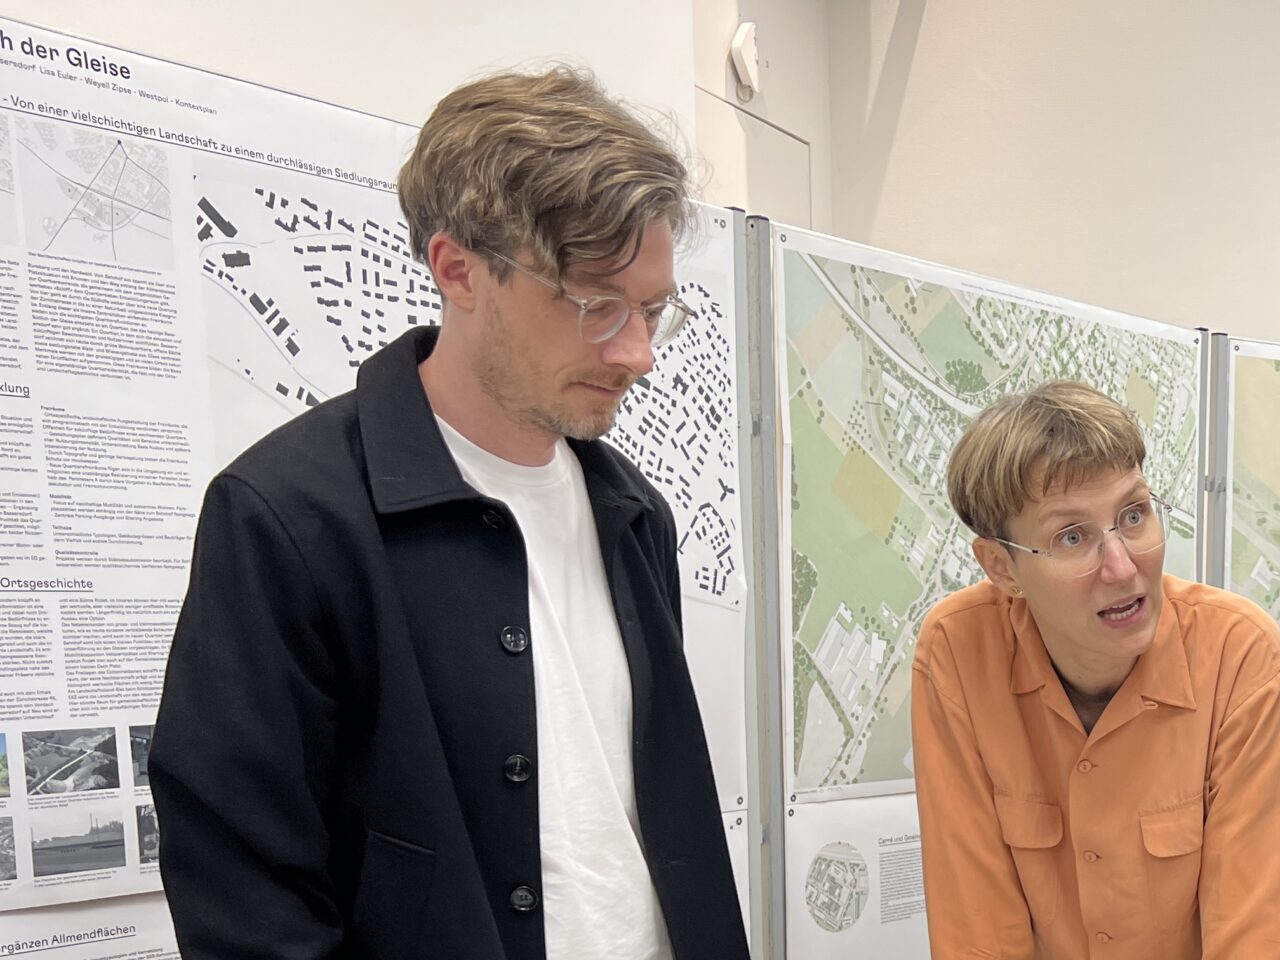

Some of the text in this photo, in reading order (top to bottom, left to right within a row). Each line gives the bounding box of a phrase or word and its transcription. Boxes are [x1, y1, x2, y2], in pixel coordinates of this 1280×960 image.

[20, 37, 60, 61] der
[66, 47, 131, 79] Gleise
[39, 66, 56, 77] Lisa
[57, 69, 79, 82] Euler
[138, 89, 169, 103] Westpol
[10, 94, 35, 111] Von
[37, 101, 69, 118] einer
[71, 109, 156, 137] vielschichtigen
[158, 127, 219, 150] Landschaft
[220, 143, 233, 154] zu
[234, 144, 265, 161] einem
[266, 152, 333, 177] durchlässigen
[0, 577, 94, 591] Ortsgeschichte
[1, 924, 137, 954] rgänzen Allmendflächen
